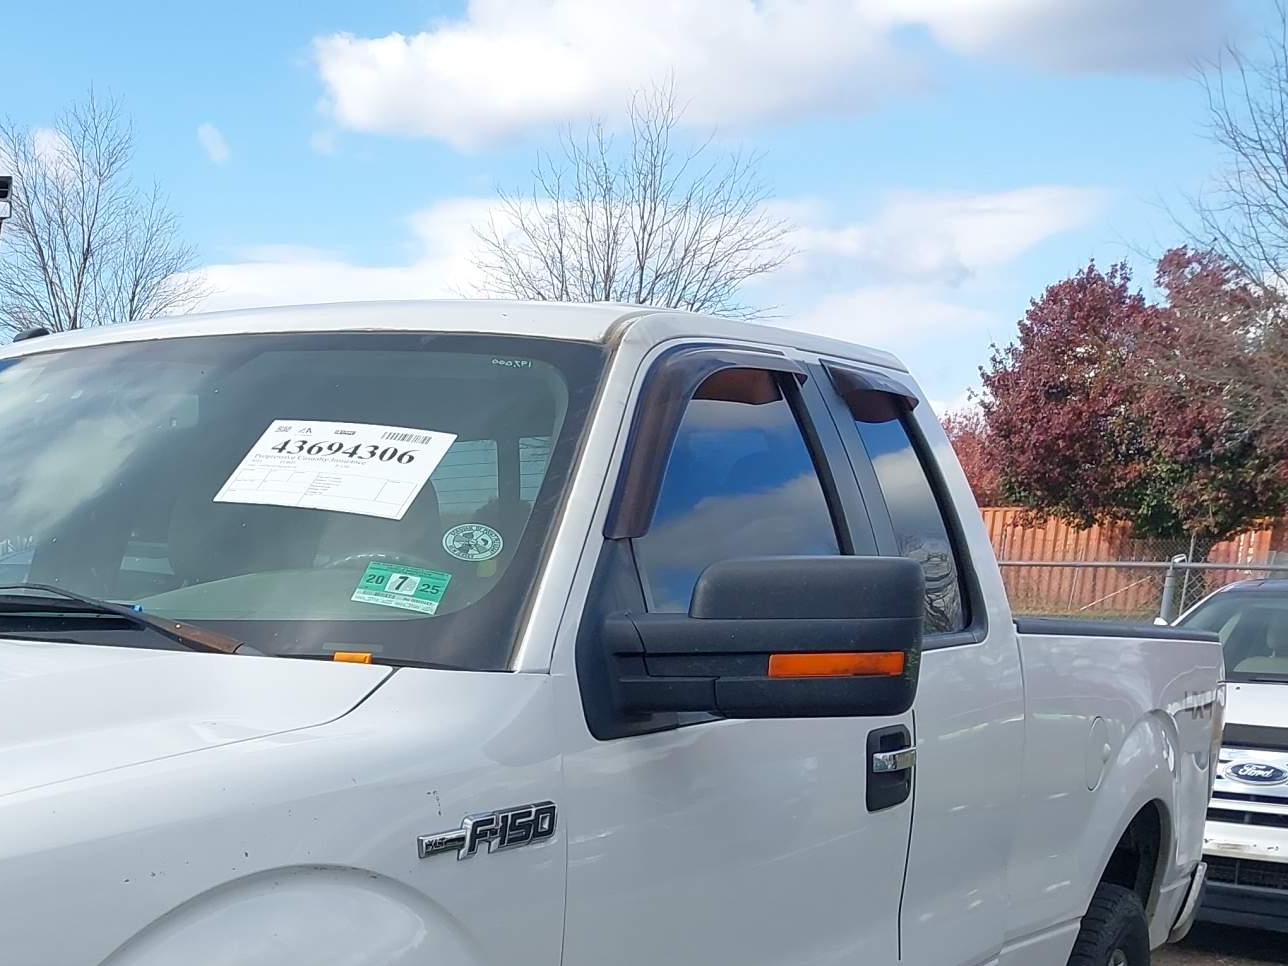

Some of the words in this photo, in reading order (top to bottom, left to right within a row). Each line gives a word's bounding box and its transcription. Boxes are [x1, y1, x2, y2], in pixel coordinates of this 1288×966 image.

[271, 439, 417, 465] 43694306
[365, 574, 385, 585] 20
[395, 576, 409, 590] 7
[418, 583, 440, 595] 25
[1238, 763, 1275, 778] Ford
